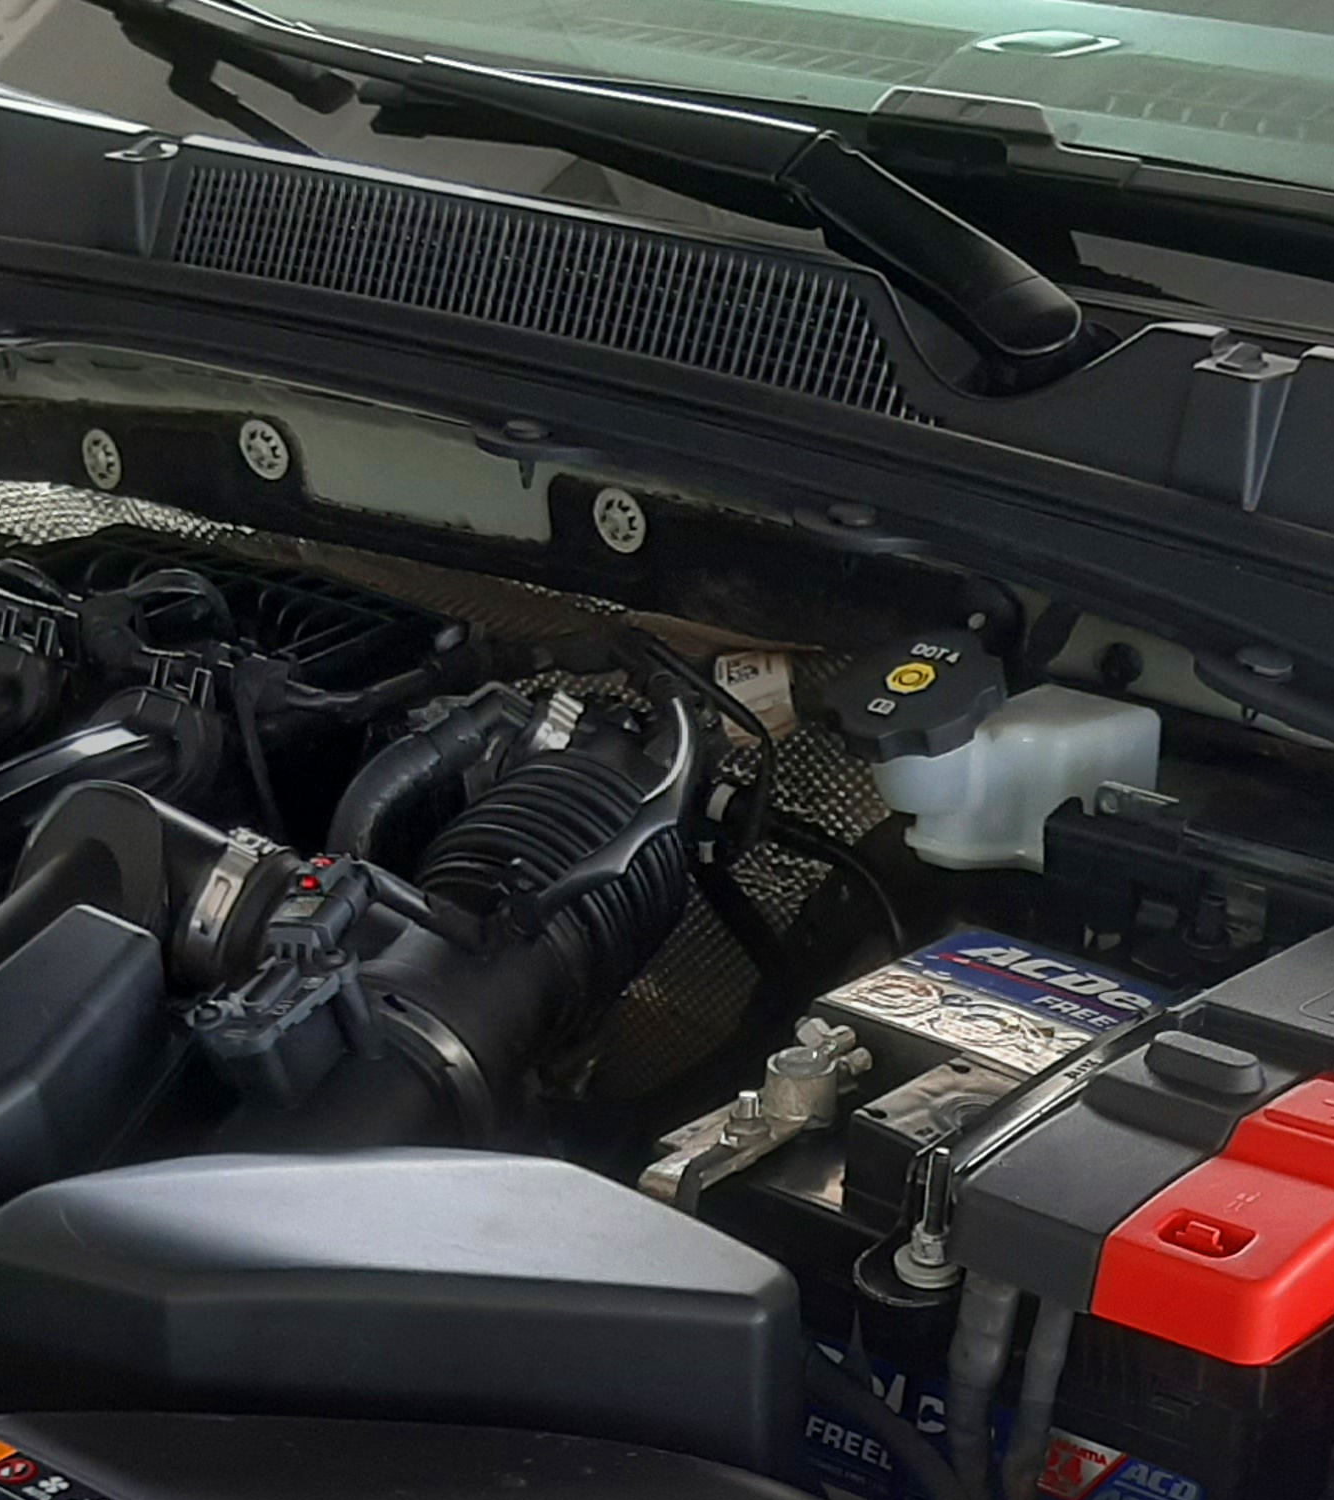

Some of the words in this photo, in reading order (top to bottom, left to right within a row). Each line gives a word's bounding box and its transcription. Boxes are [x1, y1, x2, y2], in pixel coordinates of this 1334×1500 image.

[910, 642, 951, 660] DOT
[944, 651, 961, 664] 4
[957, 946, 1152, 1011] ACDe
[1032, 995, 1120, 1029] FREE
